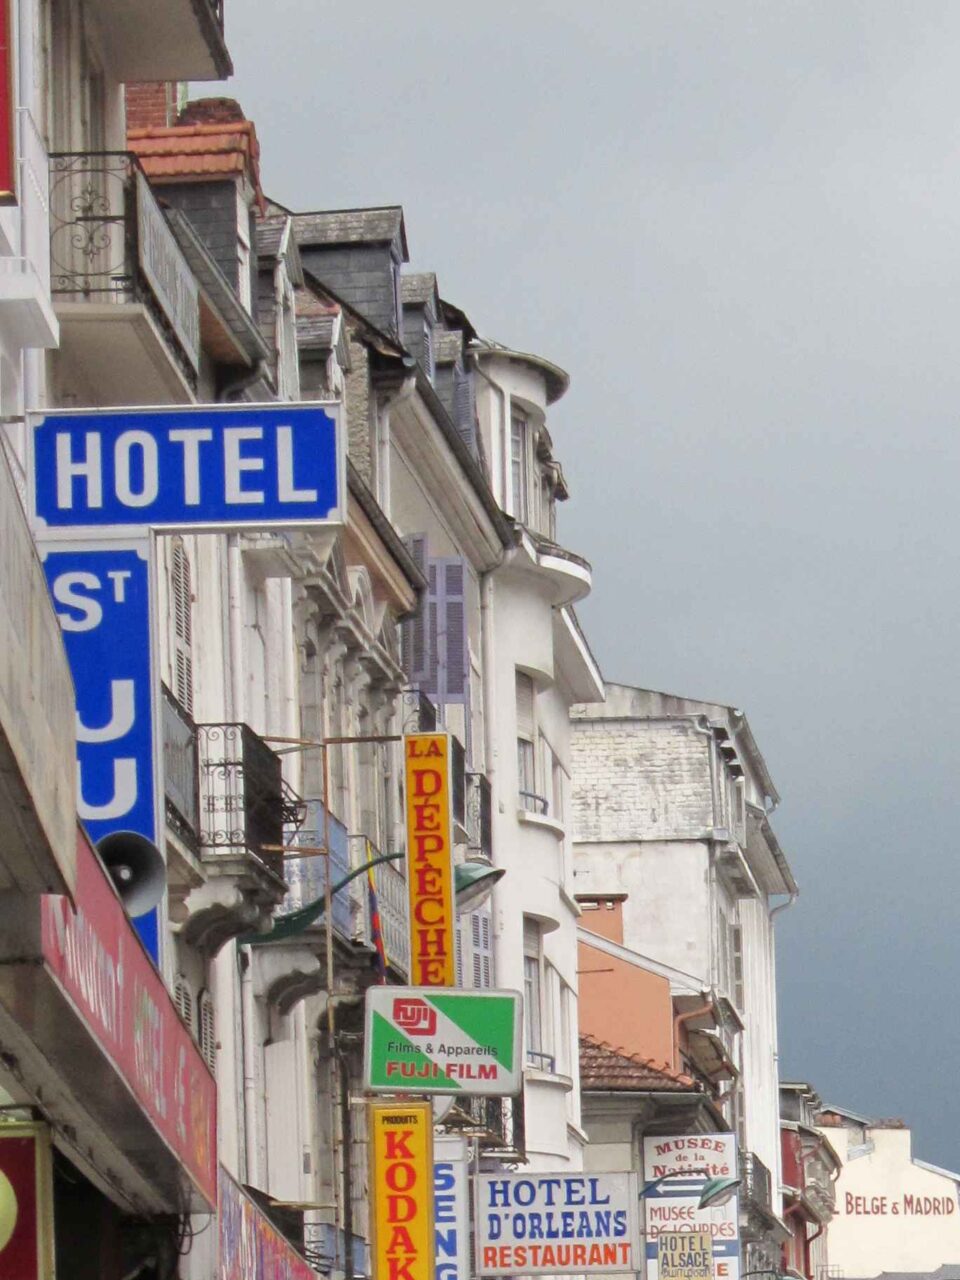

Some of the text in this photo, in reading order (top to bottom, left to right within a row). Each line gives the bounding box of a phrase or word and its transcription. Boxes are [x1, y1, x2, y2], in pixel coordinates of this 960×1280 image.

[56, 426, 317, 509] HOTEL
[408, 740, 443, 758] LA
[388, 1042, 498, 1057] Films & Appareils
[387, 1062, 497, 1079] FUJI FILM
[382, 1115, 418, 1125] PRODUITS
[654, 1138, 726, 1156] MUSEE
[675, 1153, 705, 1162] de la
[488, 1178, 610, 1207] HOTEL
[845, 1191, 887, 1215] BELGE
[904, 1194, 954, 1215] MADRID
[650, 1206, 695, 1221] MUSEE
[488, 1210, 627, 1240] D'ORLEANS
[484, 1243, 631, 1268] RESTAURANT
[661, 1252, 709, 1268] ALSACE
